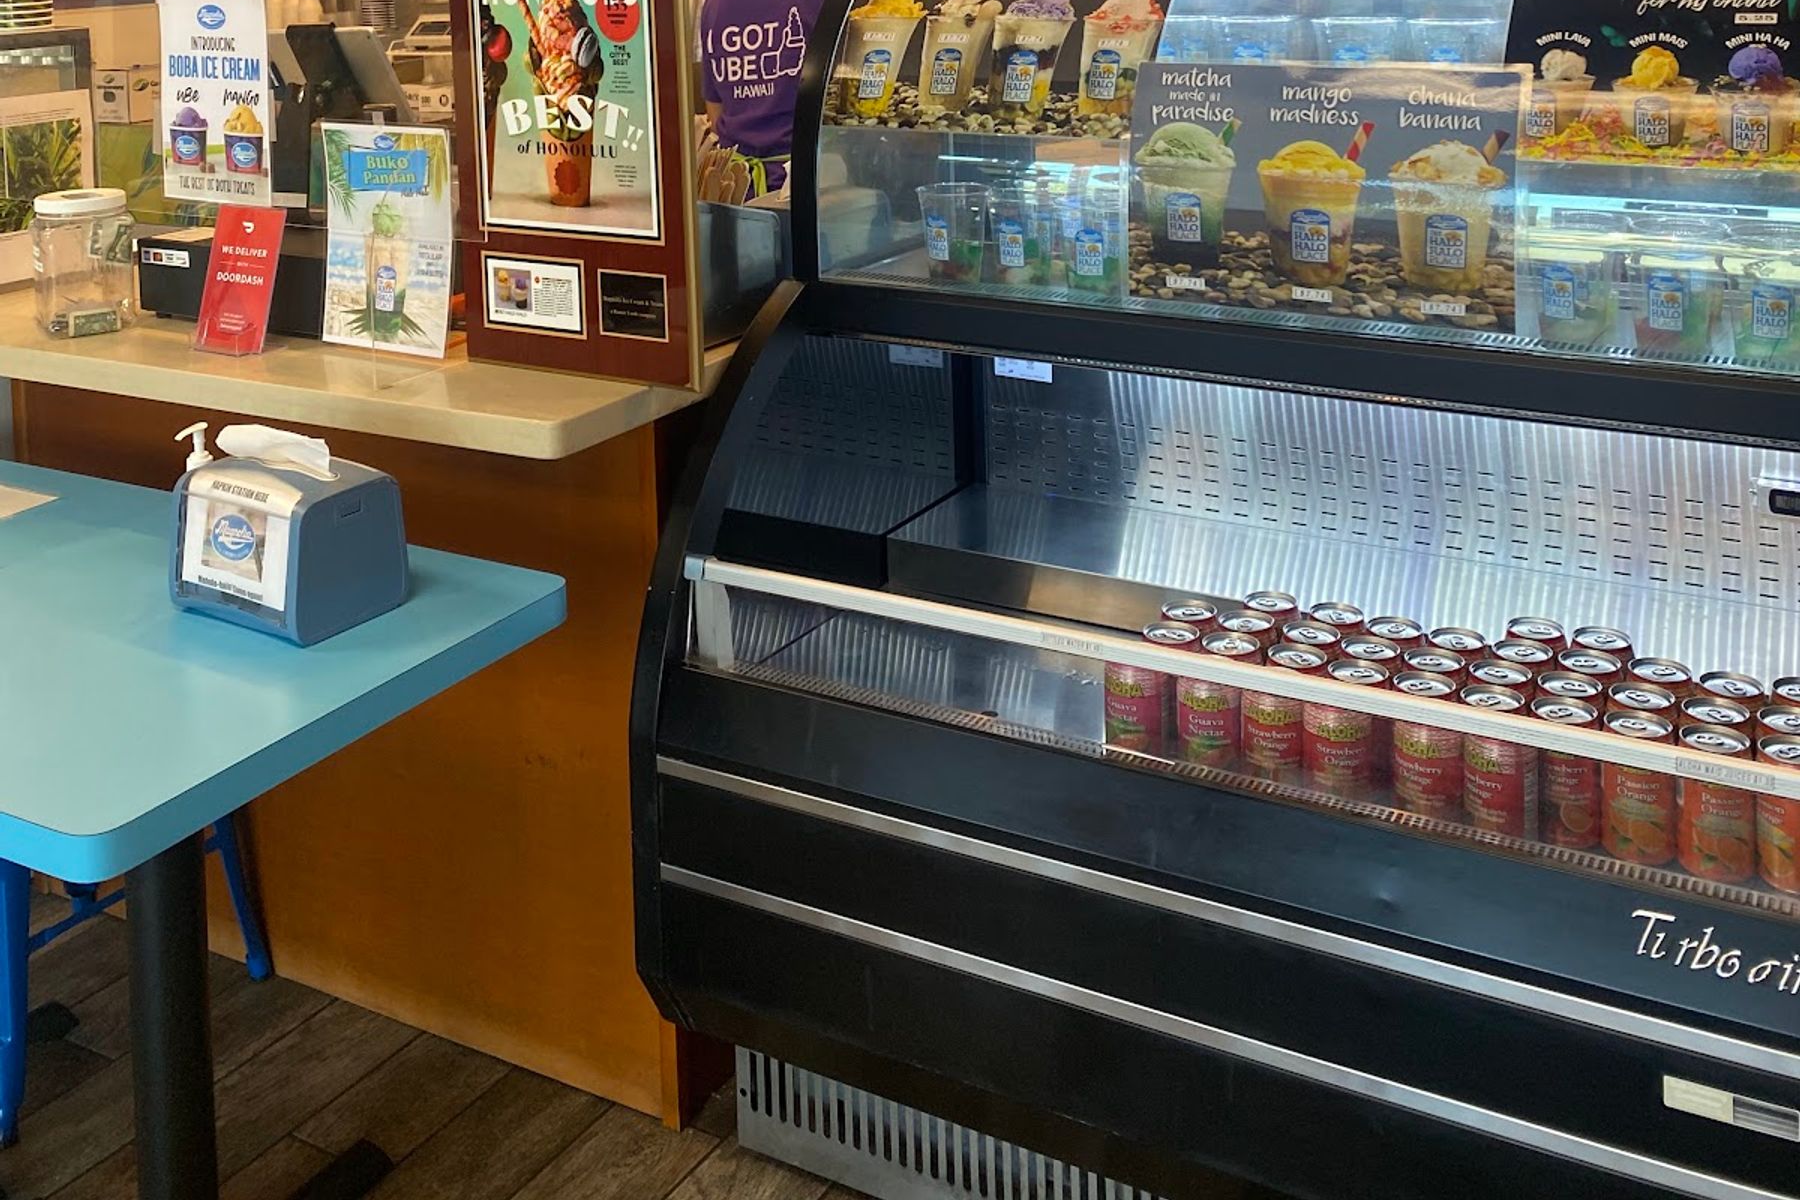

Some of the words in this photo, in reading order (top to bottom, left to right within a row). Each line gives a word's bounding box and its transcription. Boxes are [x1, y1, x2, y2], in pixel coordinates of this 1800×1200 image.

[190, 35, 236, 52] INTRODUCING
[707, 29, 713, 54] I
[721, 22, 779, 52] GOT
[1536, 32, 1562, 47] MINI
[1565, 32, 1592, 48] LAVA
[1629, 32, 1656, 48] MINI
[1658, 32, 1689, 49] MAIS
[1725, 32, 1752, 49] MINI
[1755, 32, 1771, 42] HA
[1773, 36, 1790, 50] HA
[169, 54, 199, 78] BOBA
[201, 55, 218, 79] ICE
[222, 56, 261, 81] CREAM
[711, 55, 758, 82] UBE
[1162, 68, 1232, 87] matcha
[733, 82, 774, 99] HAWAII
[1169, 88, 1206, 101] made
[1282, 85, 1352, 108] mango
[1408, 85, 1477, 107] ohana
[1152, 102, 1234, 125] paradise
[1270, 104, 1359, 125] madness
[1400, 107, 1481, 131] banana
[517, 140, 531, 155] of
[536, 141, 618, 159] HONOLULU
[366, 155, 408, 170] Buko
[363, 171, 416, 185] Pandan
[221, 245, 234, 255] WE
[235, 247, 267, 258] DELIVER
[1294, 242, 1326, 252] HALO
[216, 271, 264, 286] DOORDASH
[211, 480, 232, 494] NAPKIN
[232, 484, 253, 499] STATION
[1189, 714, 1224, 727] Guava
[1188, 725, 1225, 737] Nectar
[1254, 737, 1289, 750] Orange
[1616, 775, 1660, 790] Passion
[1616, 787, 1658, 801] Orange
